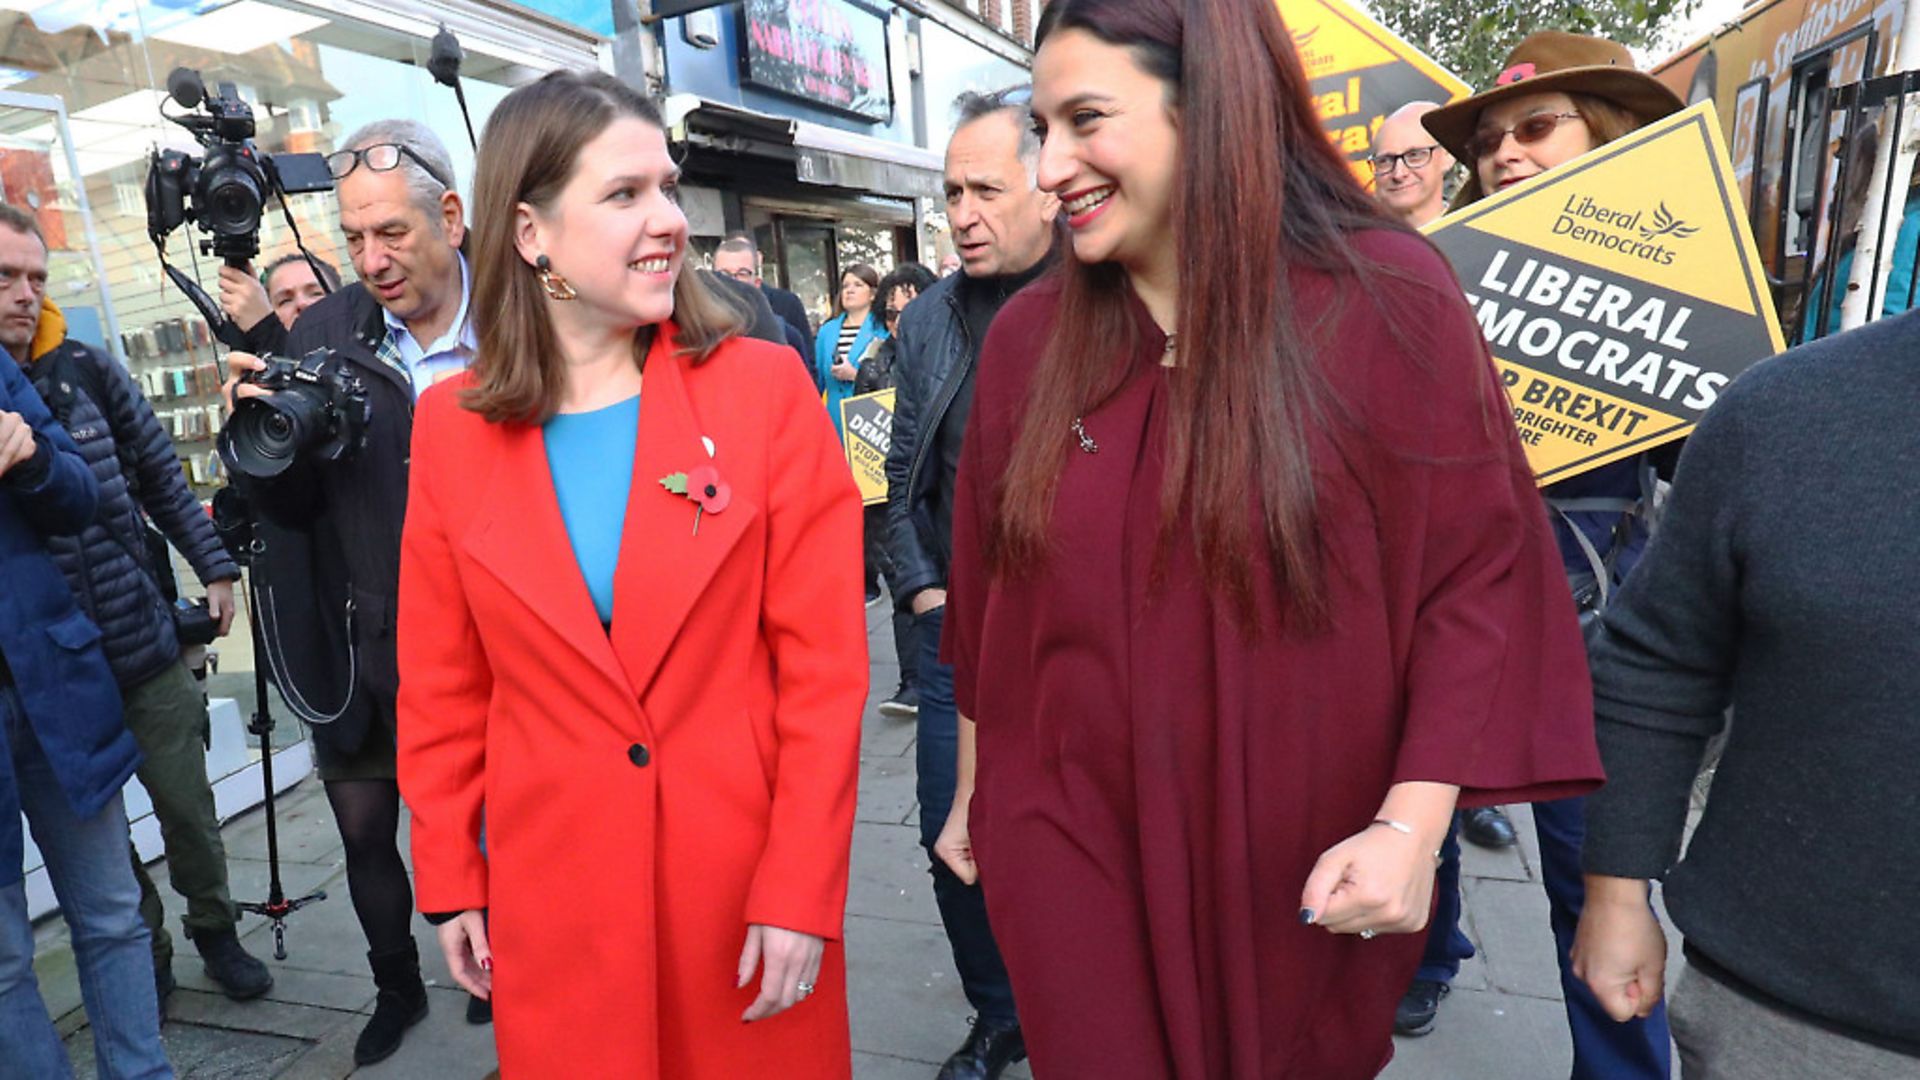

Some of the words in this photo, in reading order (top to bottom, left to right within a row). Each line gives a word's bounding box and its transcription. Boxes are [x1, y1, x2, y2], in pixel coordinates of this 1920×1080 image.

[1563, 193, 1642, 231] Liberal
[1552, 214, 1677, 266] Democrats
[1479, 250, 1693, 351] LIBERAL
[1465, 292, 1730, 412] MOCRATS
[1513, 406, 1598, 447] BRIGHTER
[1521, 378, 1648, 437] BREXIT
[854, 441, 880, 462] STOP
